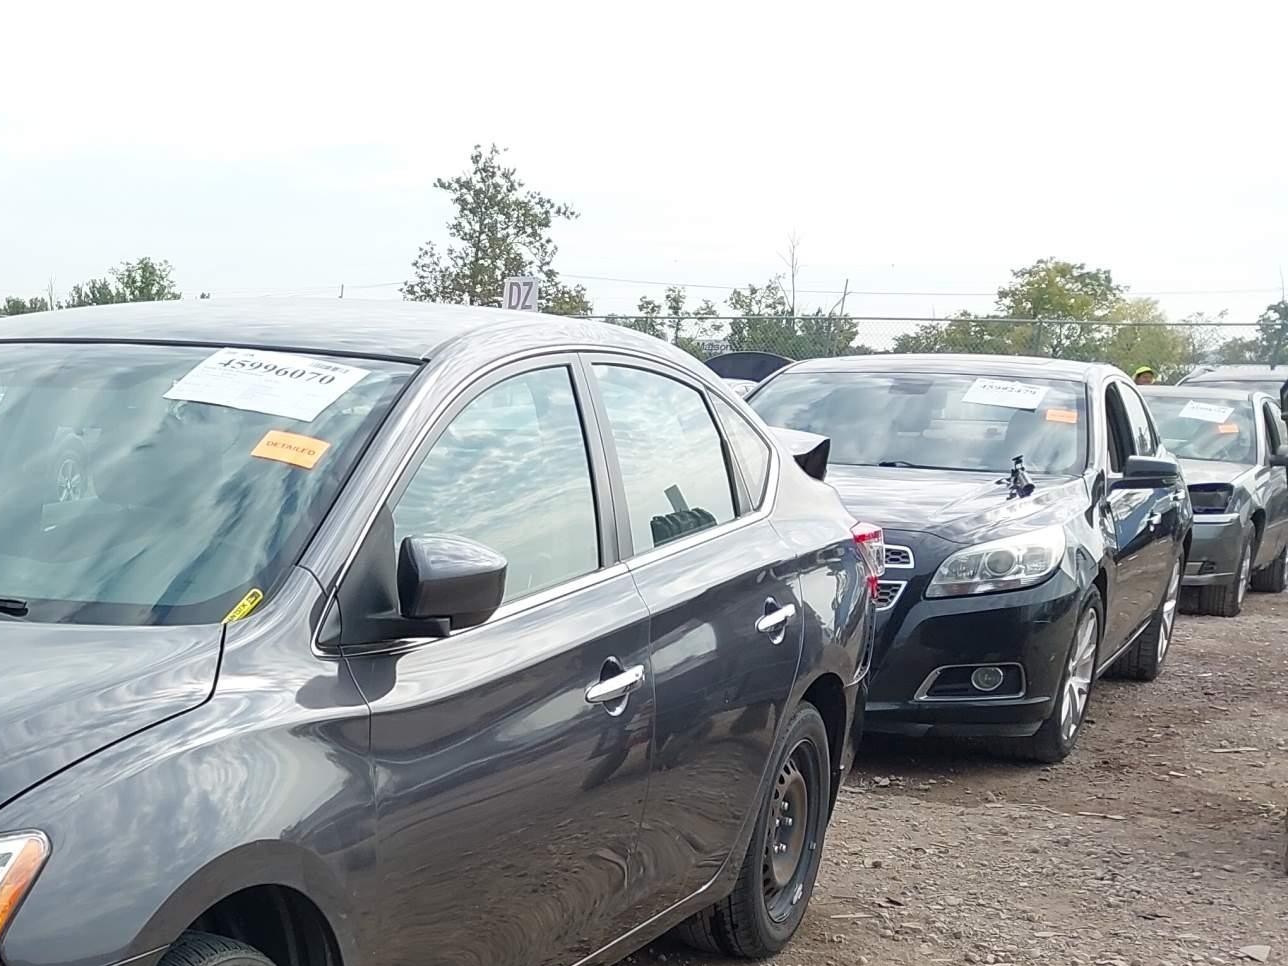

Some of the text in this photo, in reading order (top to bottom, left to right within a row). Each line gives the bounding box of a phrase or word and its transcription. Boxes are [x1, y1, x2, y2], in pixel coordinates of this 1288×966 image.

[508, 281, 534, 310] DZ
[218, 358, 336, 385] 45996070
[265, 440, 317, 456] DETAILED
